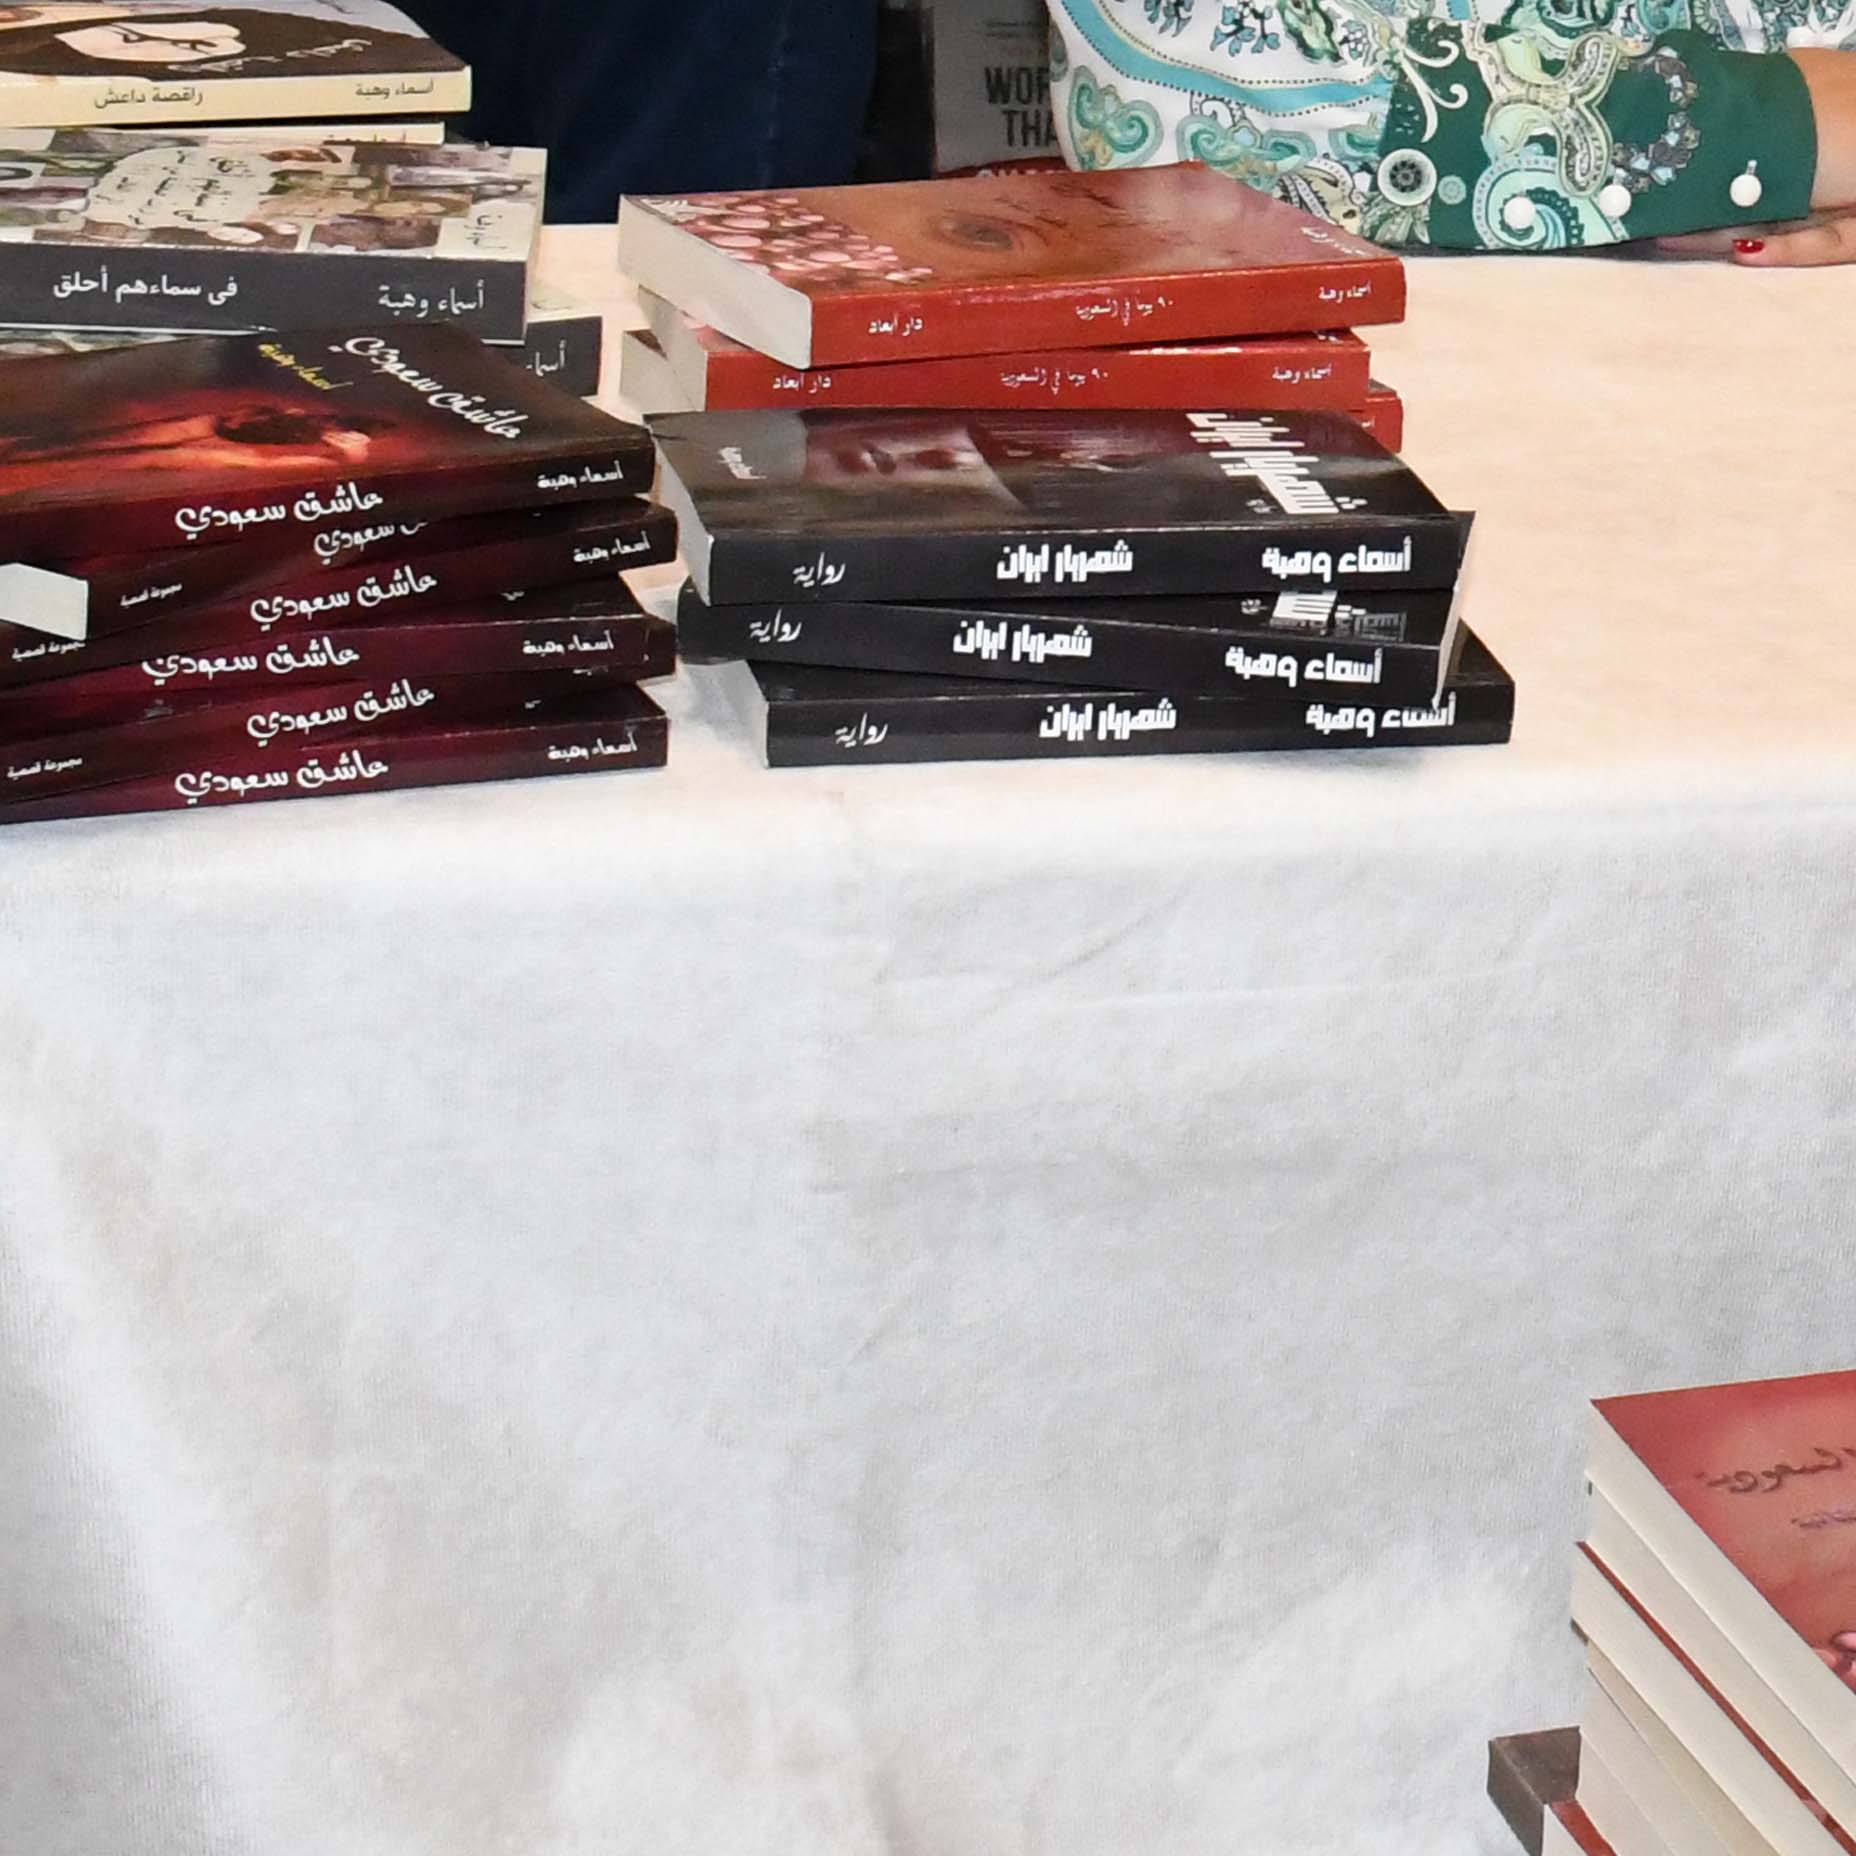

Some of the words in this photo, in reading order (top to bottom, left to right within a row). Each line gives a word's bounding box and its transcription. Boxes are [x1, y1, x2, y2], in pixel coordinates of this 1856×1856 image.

[93, 86, 149, 110] داعش
[152, 85, 203, 107] راقصة
[355, 82, 390, 99] وهبة
[537, 469, 579, 492] وهبة
[579, 459, 624, 486] أسماء
[293, 480, 384, 524] عاشق
[174, 503, 287, 539] سعودي
[572, 541, 609, 564] وهبة
[609, 532, 651, 555] أسماء
[1055, 540, 1133, 583] شهريار
[1332, 536, 1412, 576] أسماء
[792, 553, 846, 586] رواية
[1261, 544, 1332, 583] وهبة
[355, 564, 438, 607] عاشق
[249, 589, 351, 630] سعودي
[748, 610, 803, 643] رواية
[265, 637, 360, 677] عاشق
[522, 635, 567, 659] وهبة
[568, 633, 614, 656] أسماء
[1012, 627, 1092, 664] شهريار
[141, 650, 258, 687] سعودي
[1225, 646, 1298, 687] وهبة
[1304, 649, 1383, 685] أسماء
[353, 679, 435, 722] عاشق
[246, 705, 349, 747] سعودي
[547, 742, 590, 763] وهبة
[592, 732, 638, 758] أسماء
[174, 768, 289, 805] سعودي
[296, 749, 390, 789] عاشق
